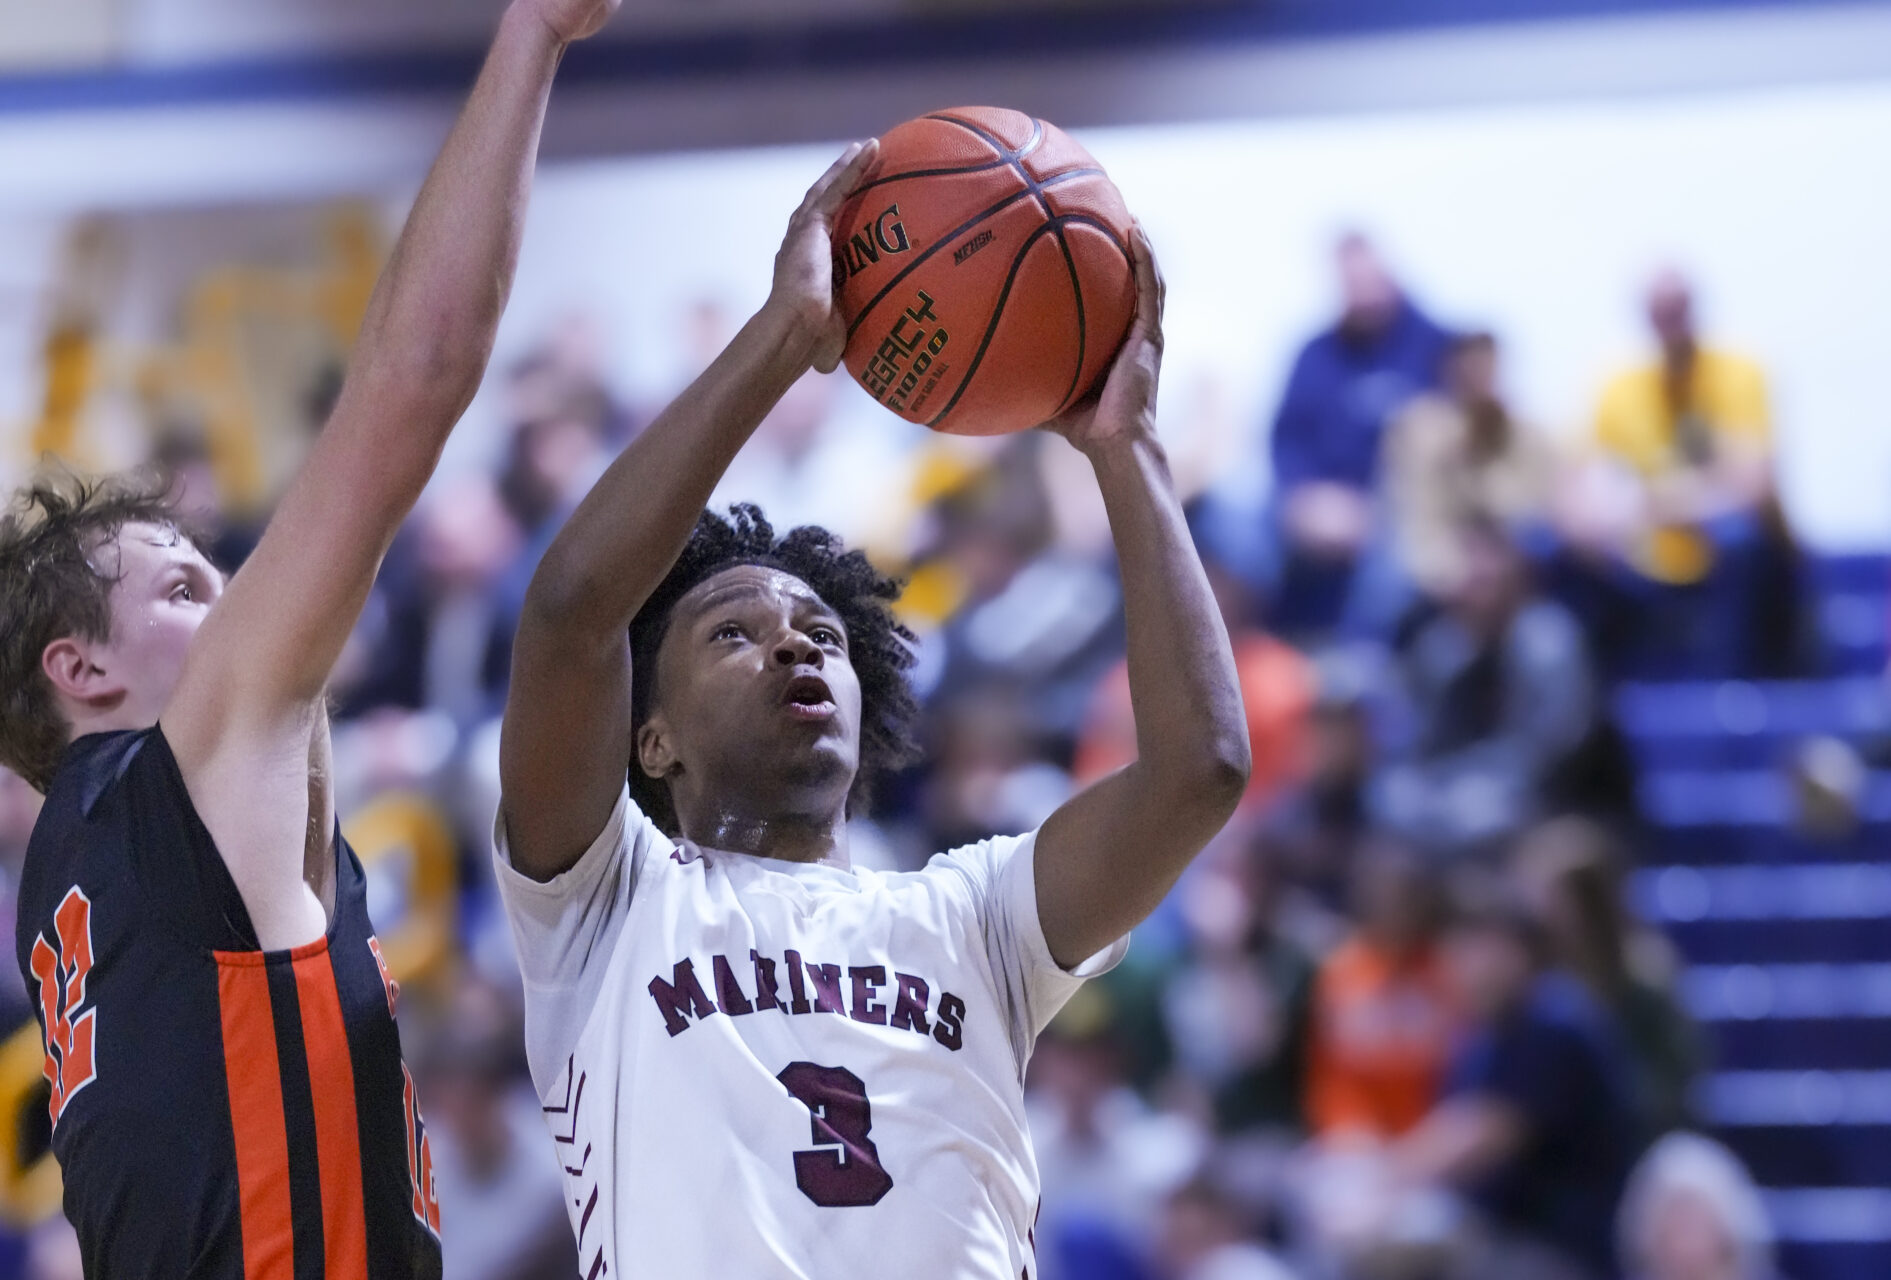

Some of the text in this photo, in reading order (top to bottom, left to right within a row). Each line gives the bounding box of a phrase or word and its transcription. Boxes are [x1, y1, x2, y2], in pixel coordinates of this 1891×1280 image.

[861, 289, 938, 402] EGACY
[647, 949, 966, 1051] MARINERS
[776, 1061, 894, 1207] 3
